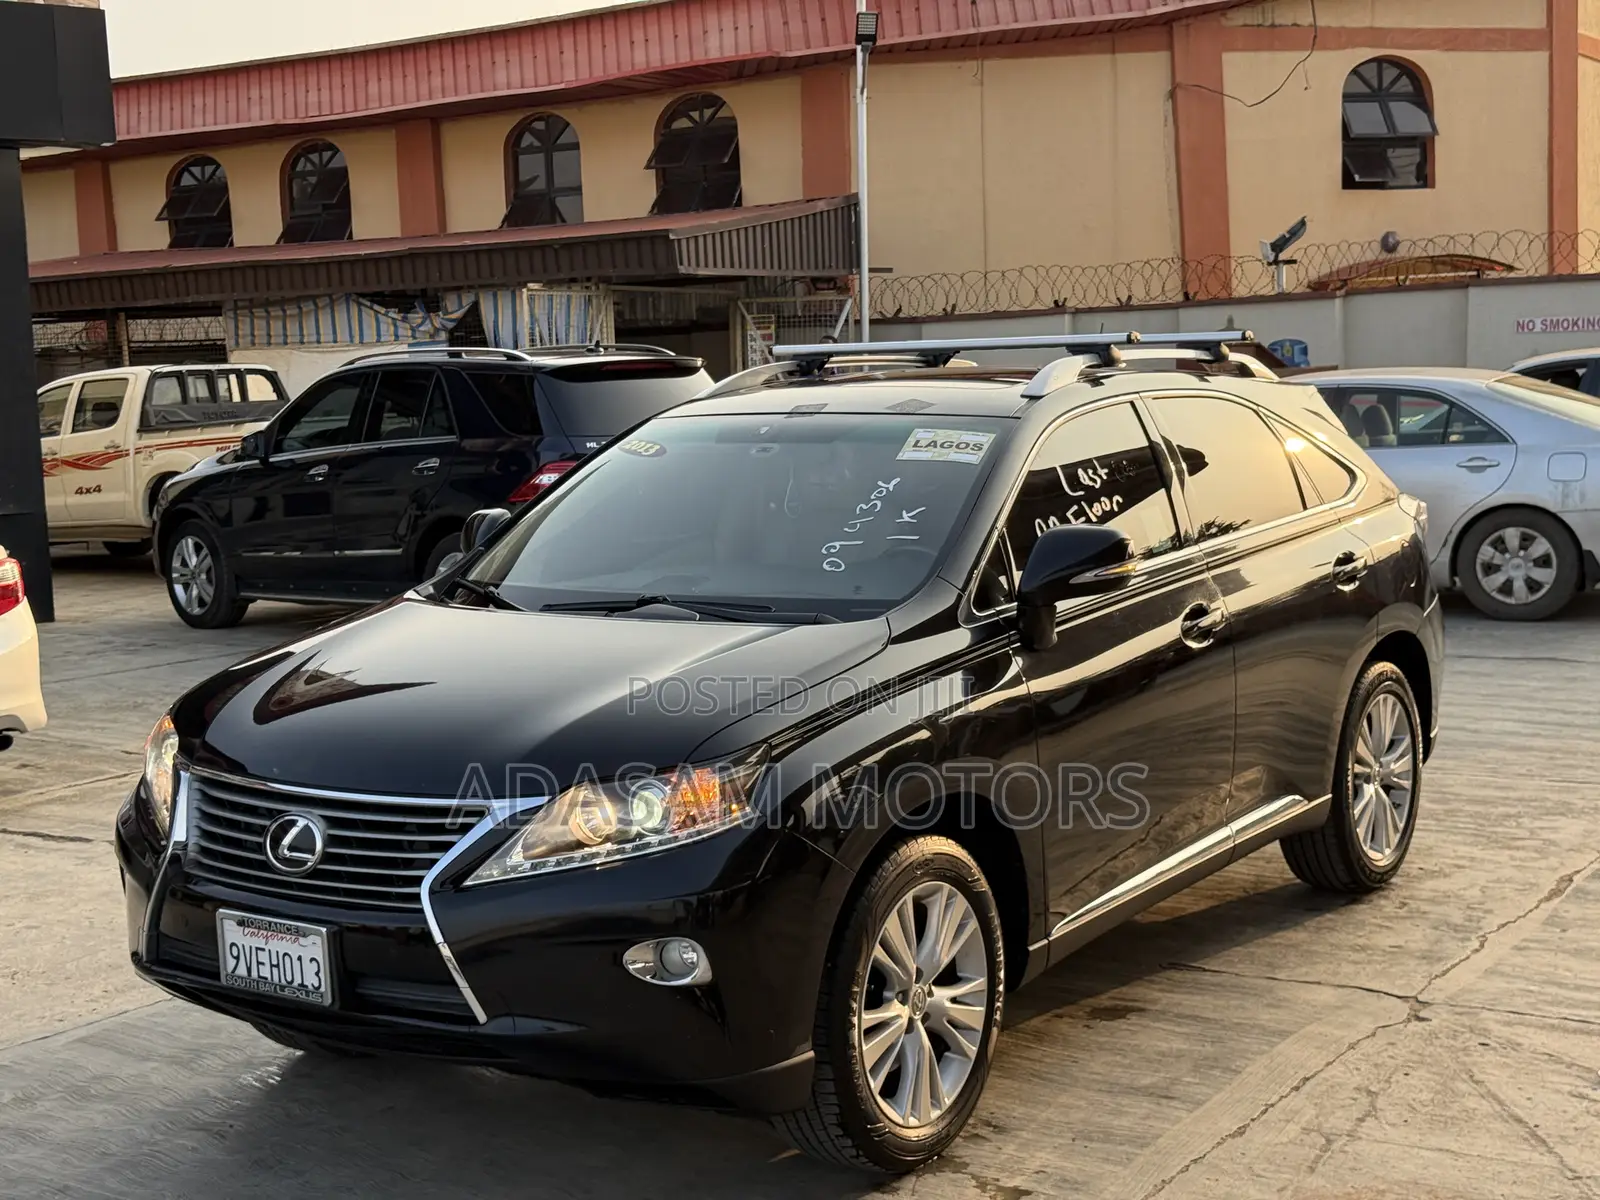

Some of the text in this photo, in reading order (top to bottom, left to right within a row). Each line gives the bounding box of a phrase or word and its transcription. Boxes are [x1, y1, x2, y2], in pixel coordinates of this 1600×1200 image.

[1516, 320, 1535, 332] NO
[621, 440, 660, 455] 2013
[912, 440, 984, 452] LAGOS
[1056, 458, 1108, 496] Last
[74, 484, 102, 495] 4x4
[243, 917, 298, 936] TORRANCE
[229, 941, 322, 991] 9VEH013
[226, 974, 323, 1003] SOUTH BAY LEXUS
